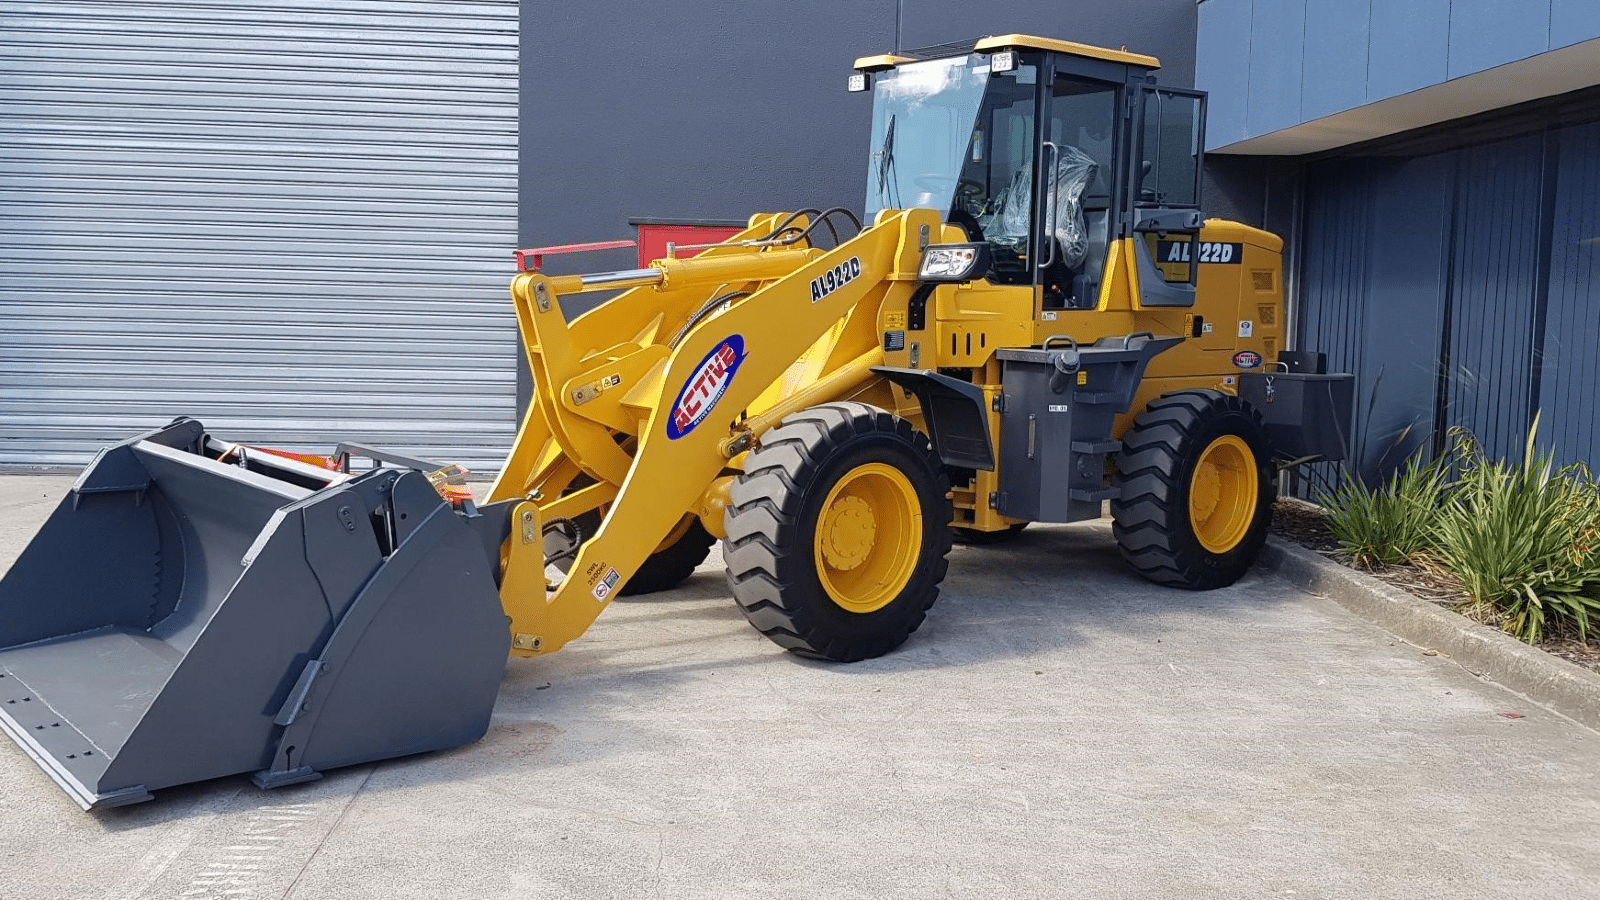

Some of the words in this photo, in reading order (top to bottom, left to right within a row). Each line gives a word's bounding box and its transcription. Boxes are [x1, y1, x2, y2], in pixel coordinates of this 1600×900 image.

[1167, 242, 1233, 263] AL22D
[810, 256, 861, 303] AL922D
[673, 343, 736, 433] ACTIVE
